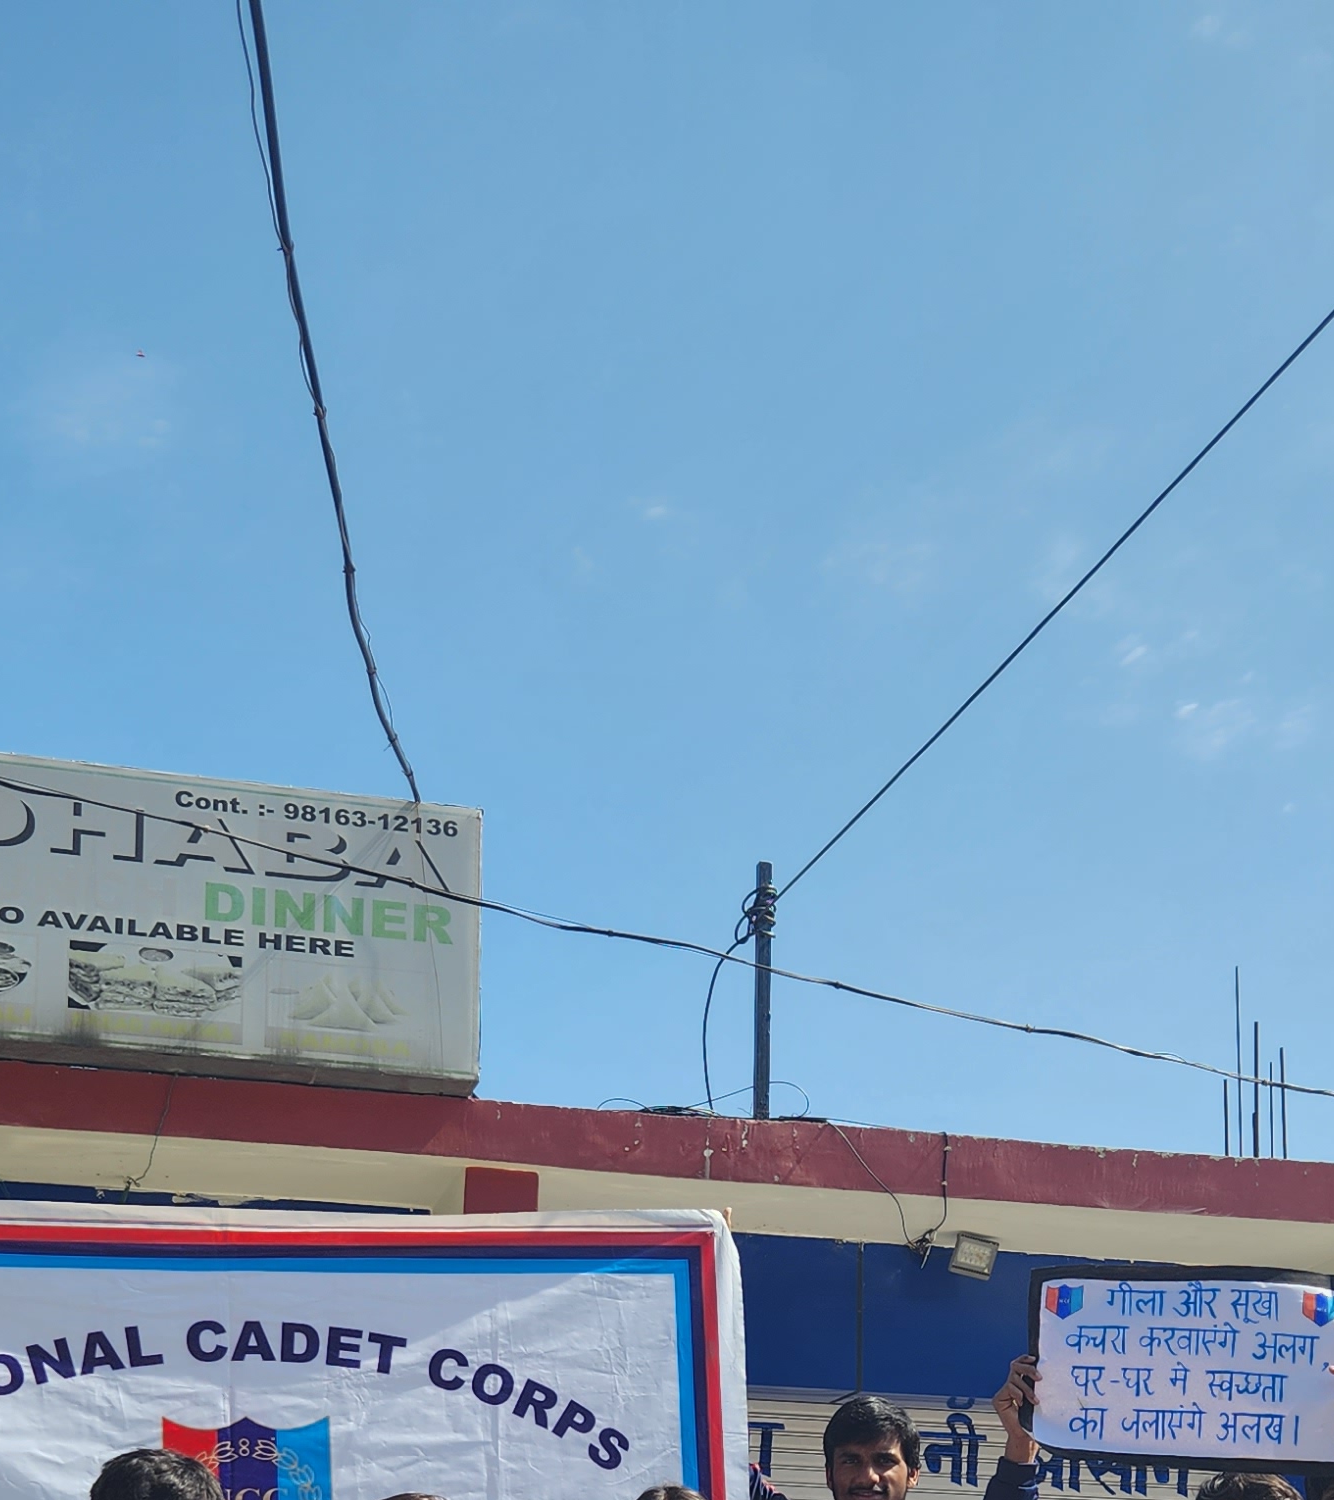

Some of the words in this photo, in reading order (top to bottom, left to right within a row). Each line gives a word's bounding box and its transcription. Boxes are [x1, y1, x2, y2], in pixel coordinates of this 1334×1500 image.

[175, 790, 248, 816] Cont.
[284, 802, 458, 838] 98163-12136
[37, 909, 245, 947] AVAILABLE
[259, 932, 355, 958] HERE
[204, 881, 453, 944] DINNER
[1107, 1282, 1166, 1317] गीला
[1173, 1281, 1221, 1319] और
[1230, 1288, 1279, 1324] सूखा
[1065, 1325, 1130, 1356] कचरा
[185, 1319, 408, 1375] CADET
[428, 1348, 631, 1471] CORPS
[1069, 1407, 1108, 1441] का
